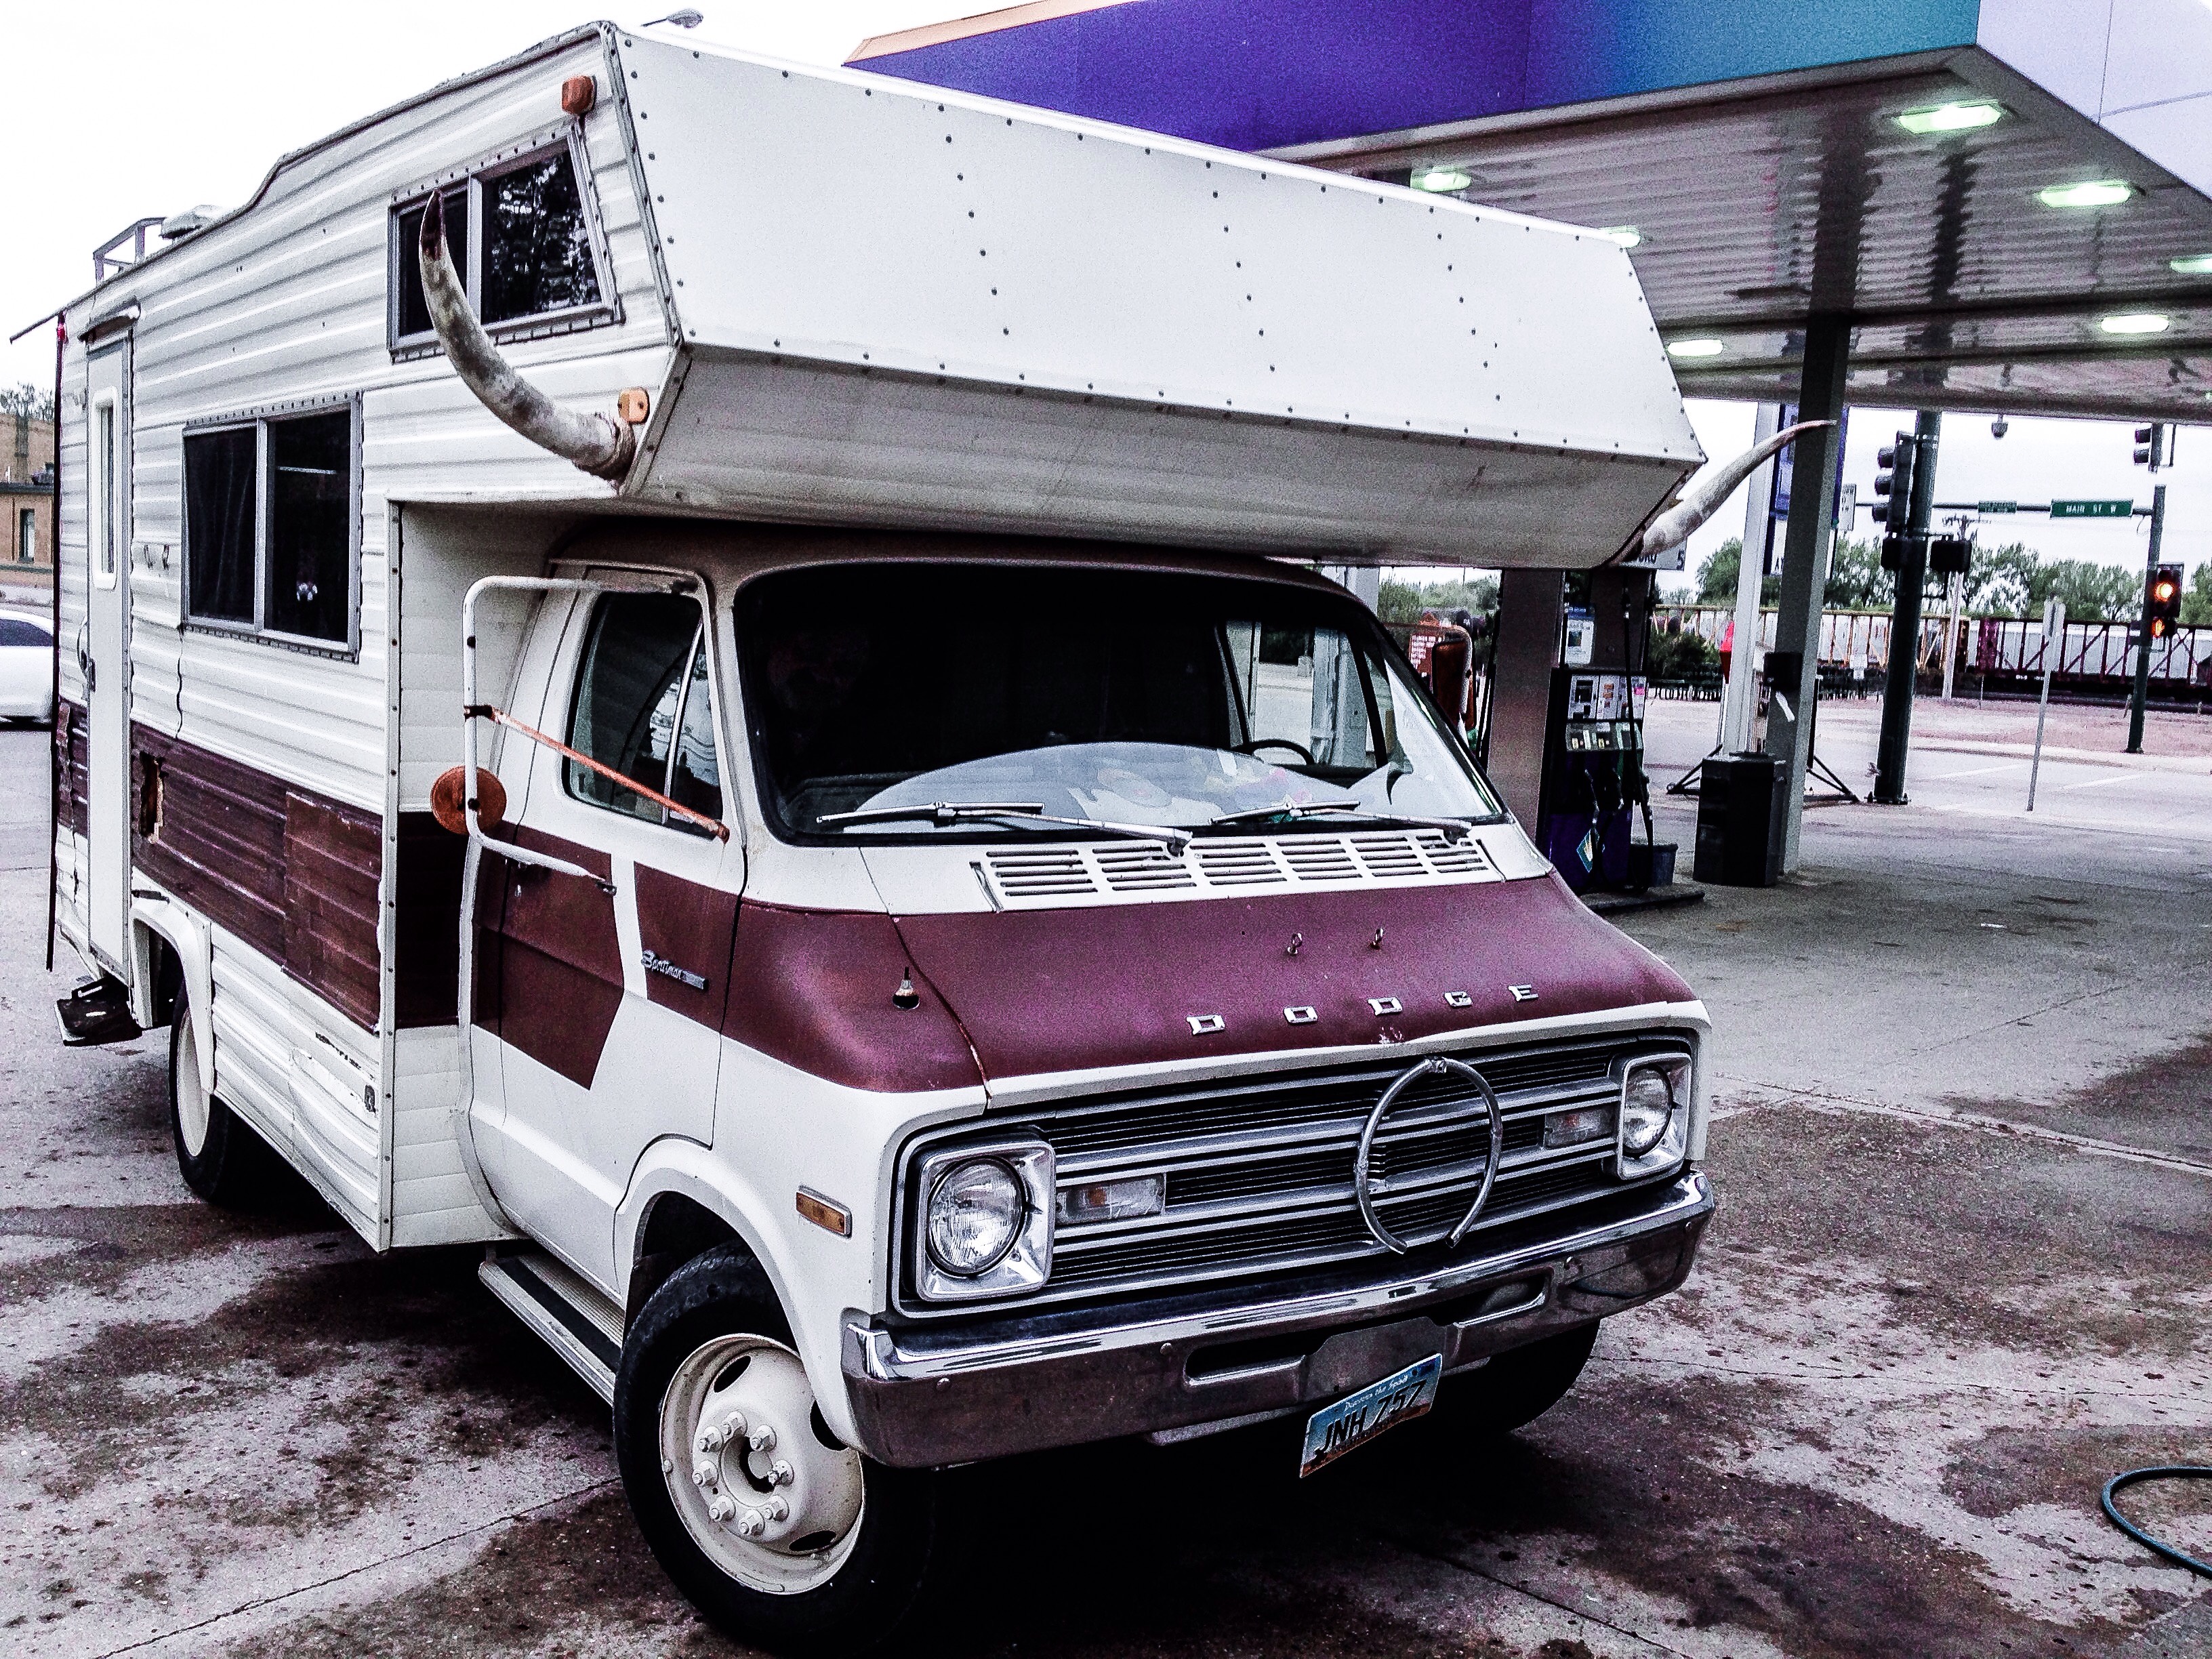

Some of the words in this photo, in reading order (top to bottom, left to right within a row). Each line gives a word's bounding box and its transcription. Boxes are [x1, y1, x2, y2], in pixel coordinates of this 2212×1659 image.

[2066, 503, 2085, 514] MAIN
[1187, 984, 1538, 1035] DODGE
[1314, 1404, 1368, 1454] JNH
[1374, 1379, 1427, 1424] 757
